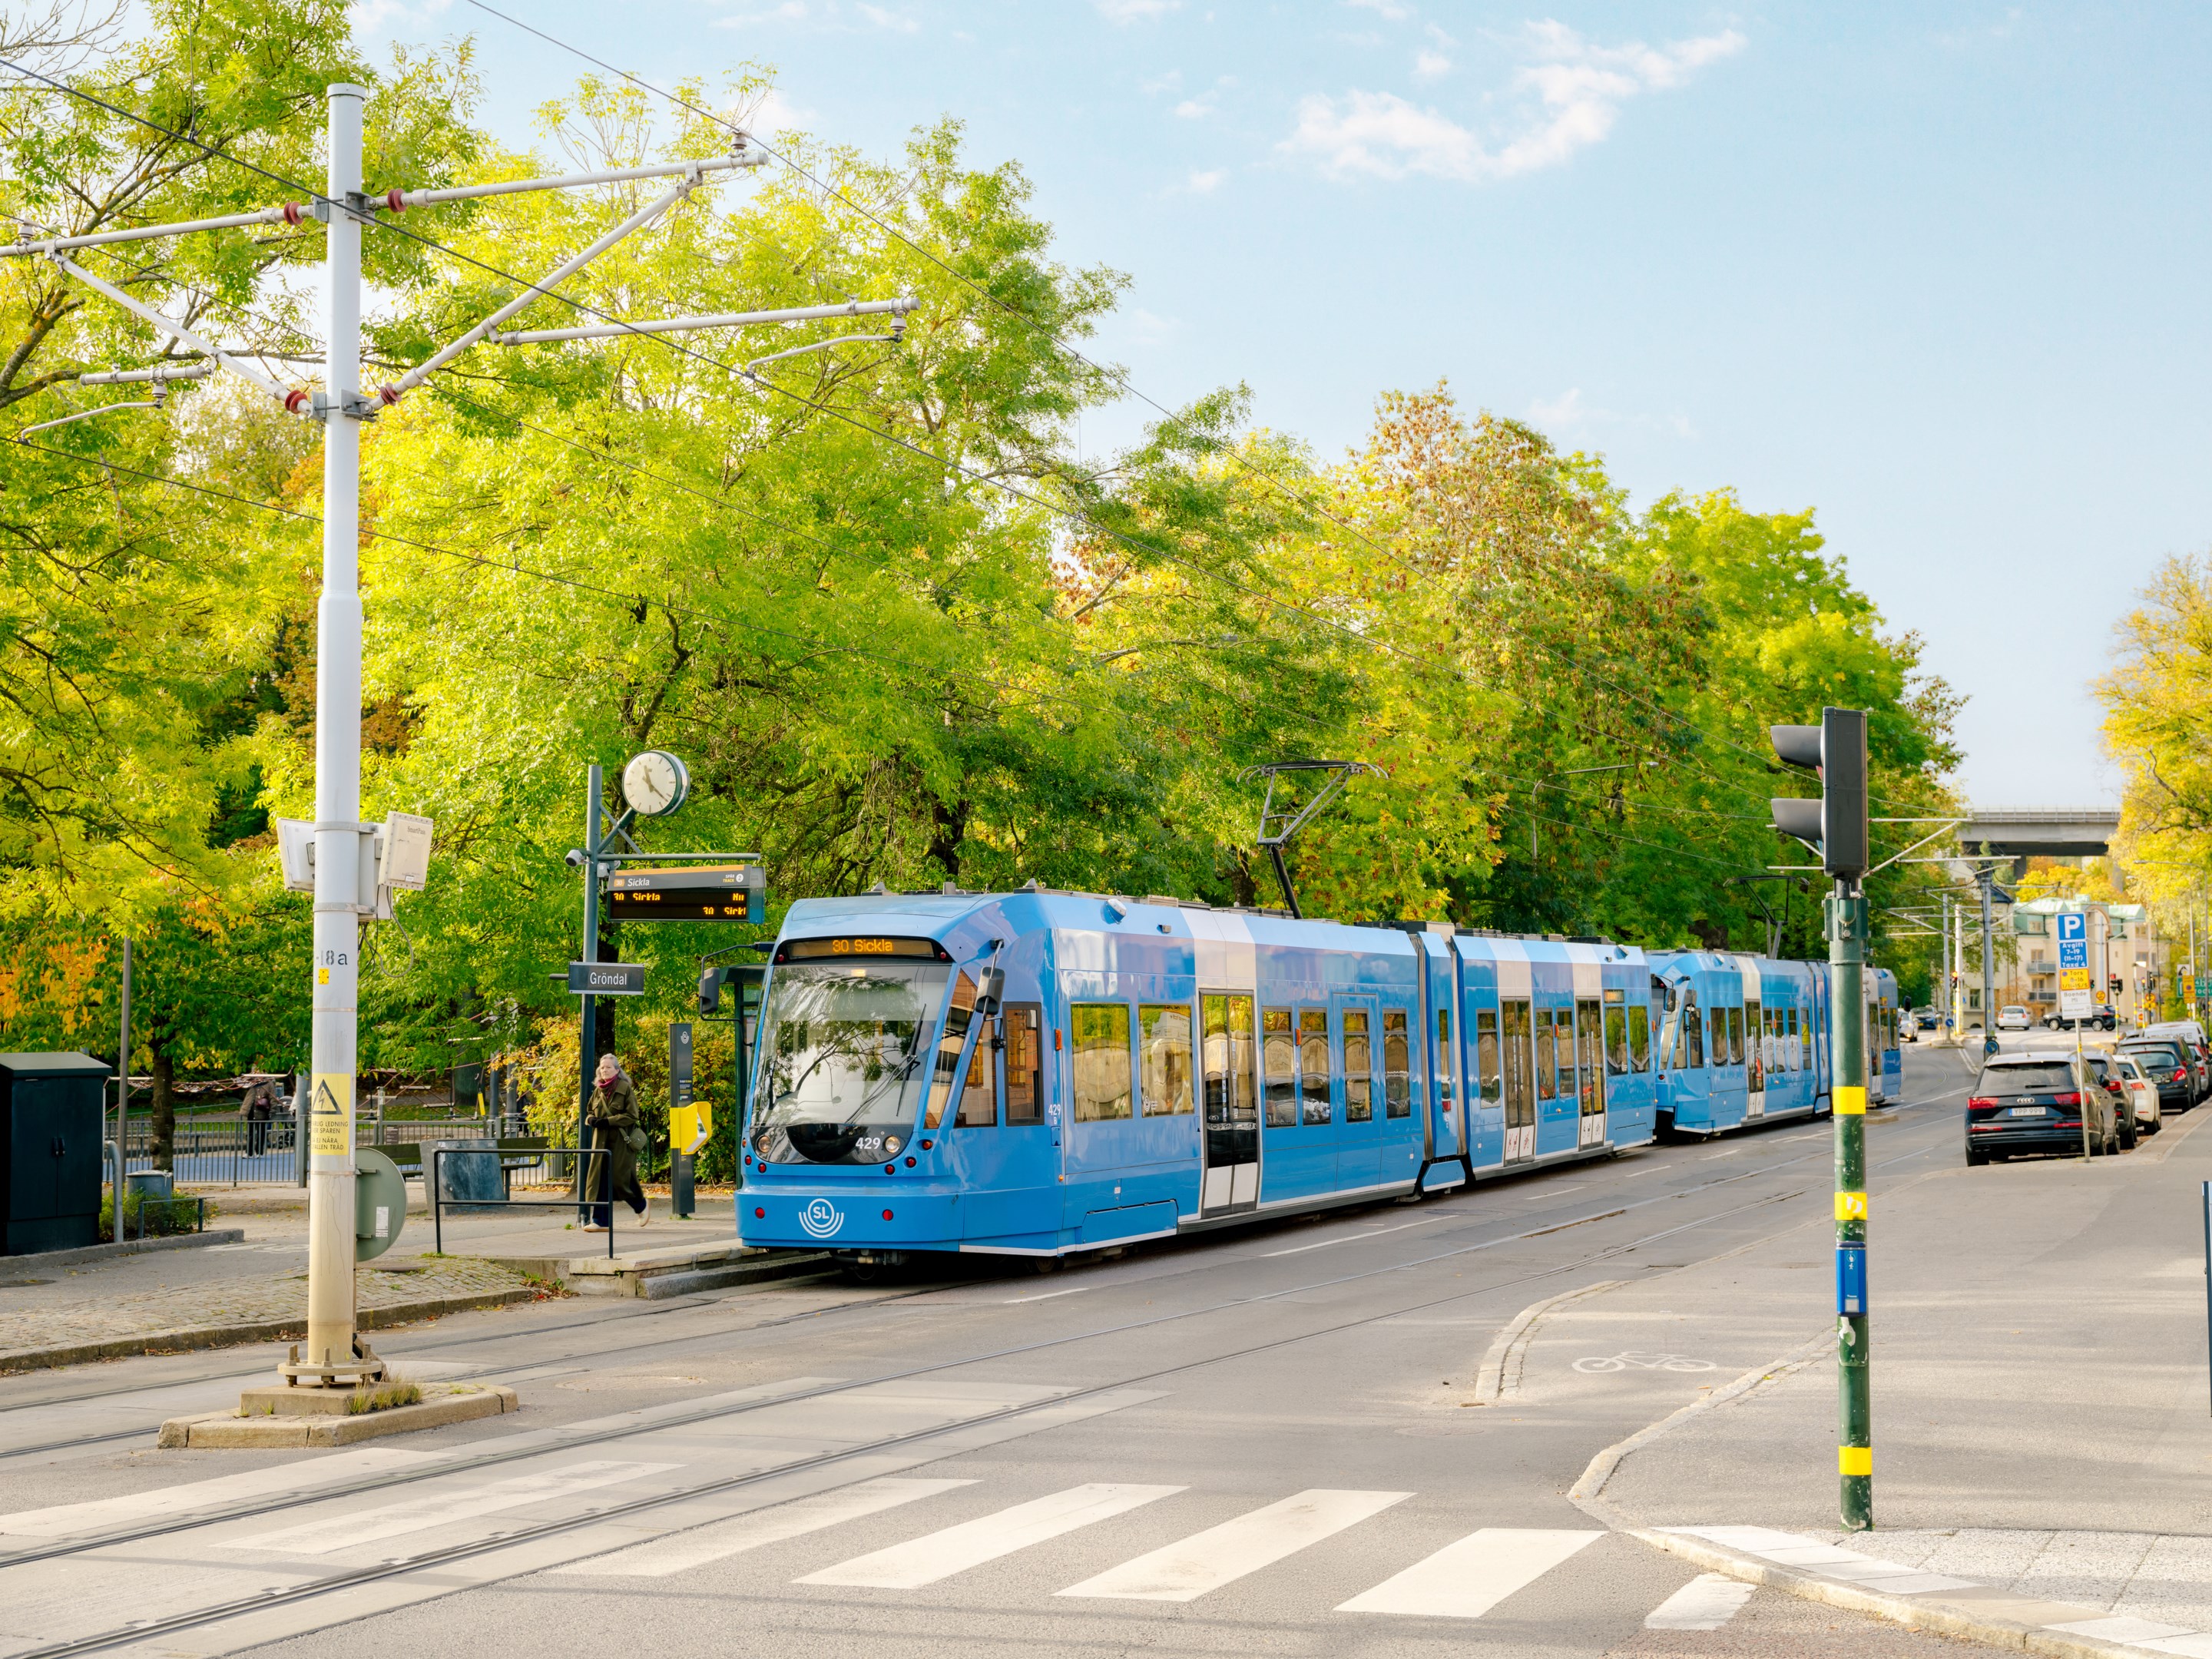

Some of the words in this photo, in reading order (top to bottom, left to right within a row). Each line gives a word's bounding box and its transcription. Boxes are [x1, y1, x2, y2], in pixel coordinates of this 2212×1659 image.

[628, 878, 650, 887] Sickla
[2064, 916, 2081, 939] P
[832, 939, 849, 952] 30
[854, 939, 893, 952] Sickla
[590, 972, 628, 985] Gröndal
[1048, 1104, 1061, 1116] 429
[1053, 1116, 1058, 1124] B
[855, 1137, 881, 1150] 429
[813, 1206, 830, 1219] SL
